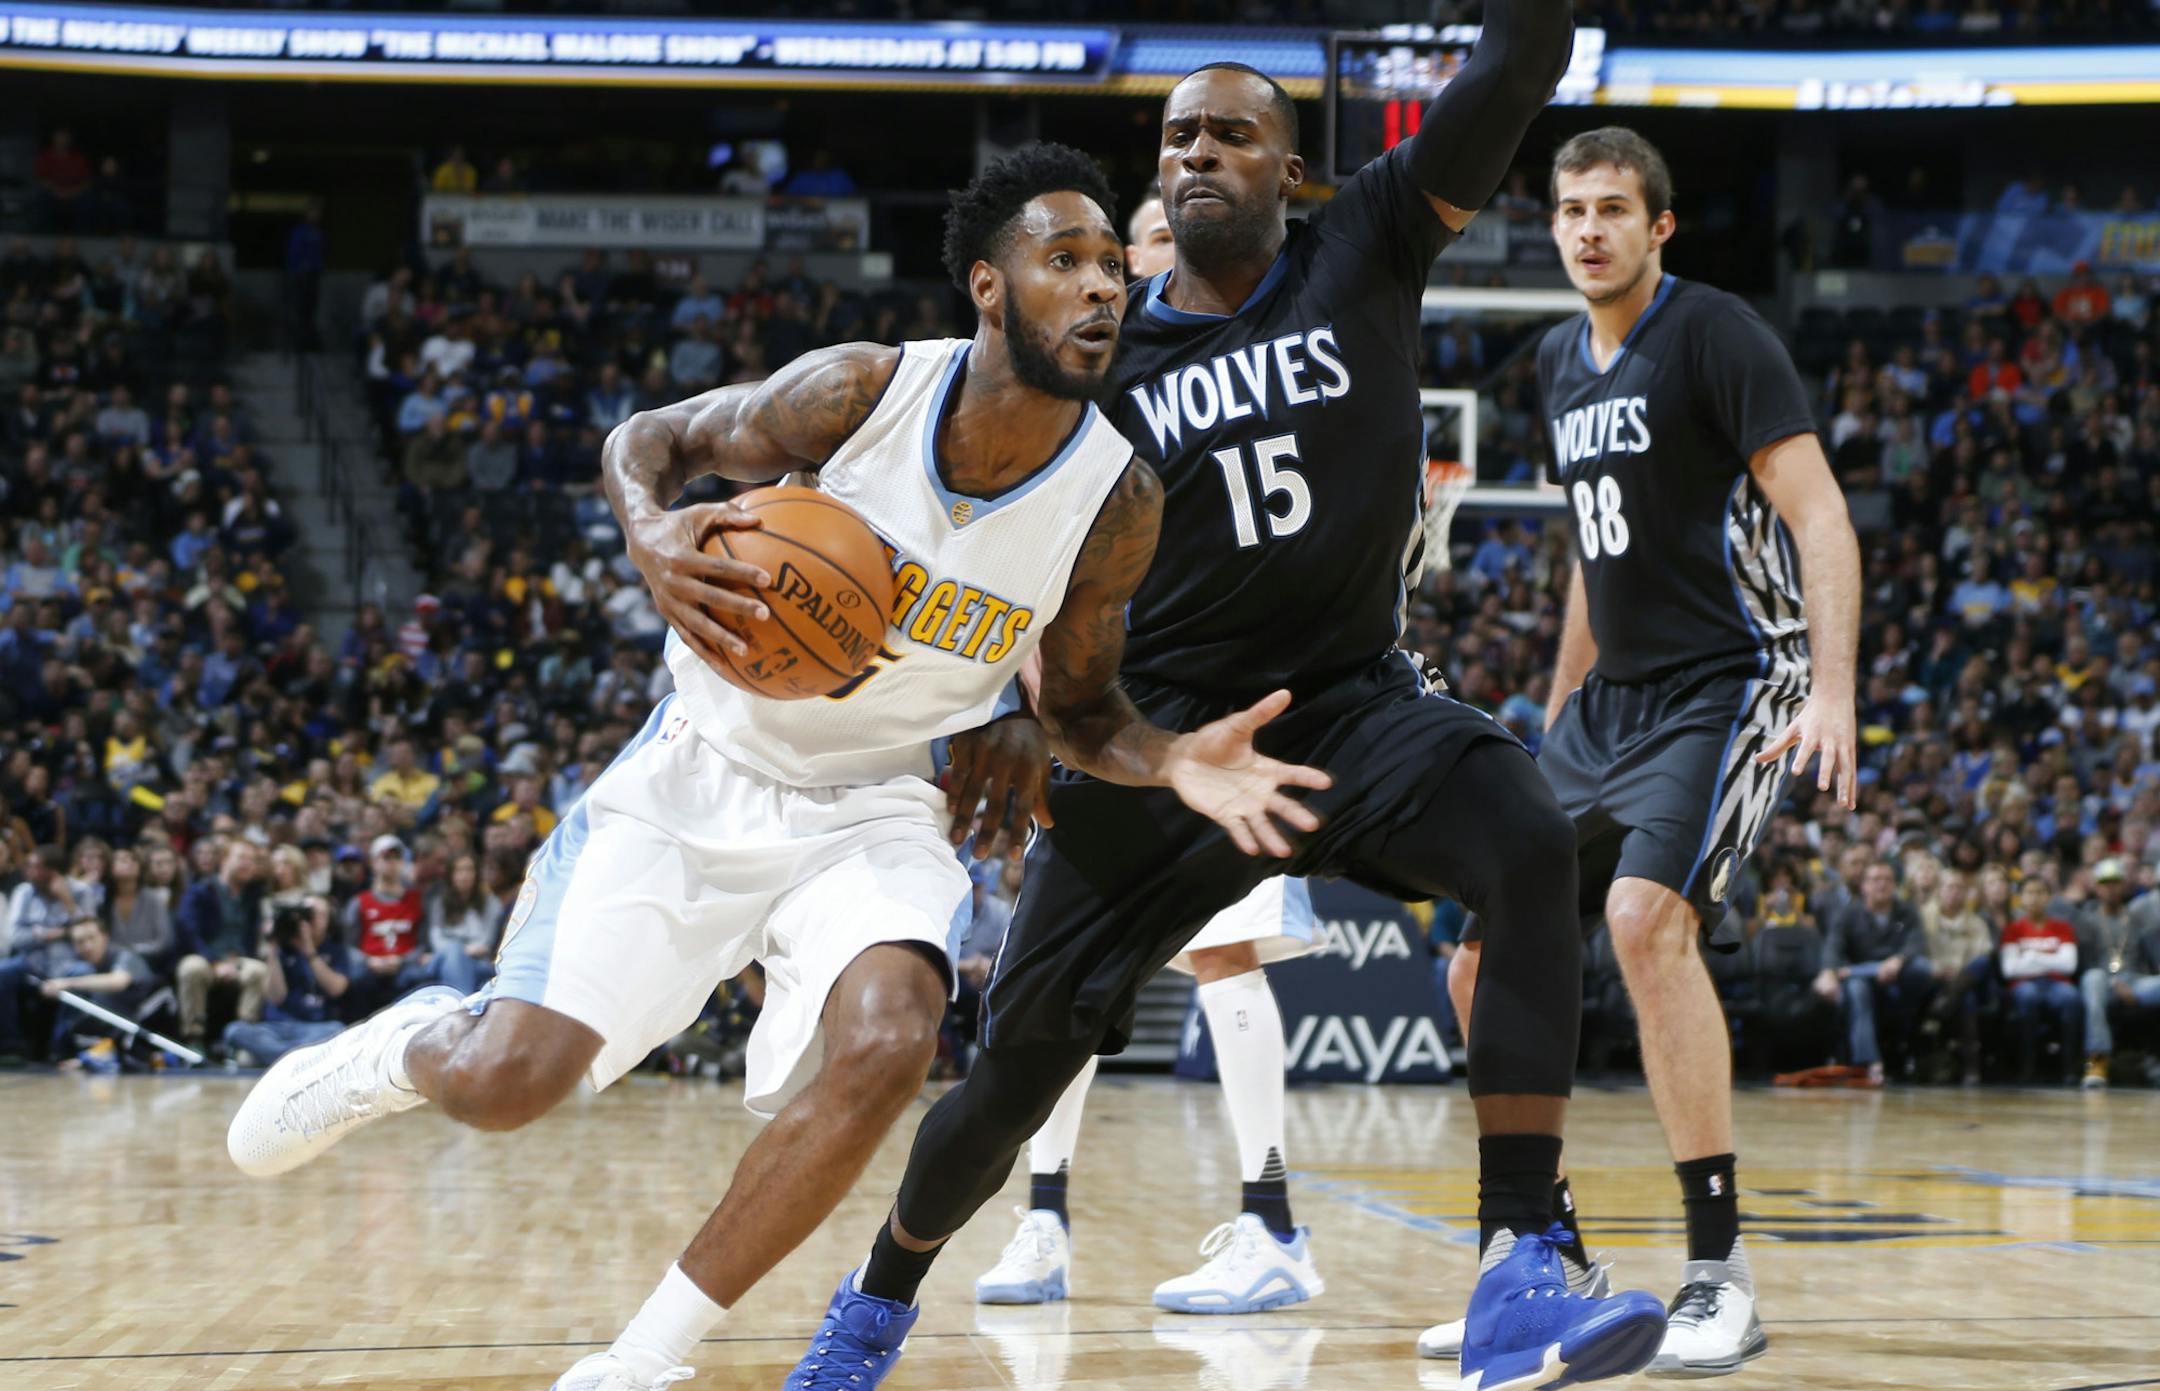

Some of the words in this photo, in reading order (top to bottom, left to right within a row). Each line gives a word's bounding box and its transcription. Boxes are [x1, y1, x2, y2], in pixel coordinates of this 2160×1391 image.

[11, 16, 58, 45] THE
[188, 27, 287, 56] WEEKLY
[289, 29, 367, 58] SHOW
[435, 31, 549, 61] MICHAEL
[553, 33, 661, 63] MALONE
[773, 37, 945, 68] WEDNESDAYS
[949, 39, 982, 69] AT
[1042, 41, 1085, 70] PM
[538, 209, 588, 229] MAKE
[601, 209, 631, 229] THE
[711, 210, 752, 231] CALL
[1128, 323, 1351, 458] WOLVES
[1552, 395, 1651, 477] WOLVES
[1211, 431, 1312, 549] 15
[1572, 475, 1630, 561] 88
[770, 562, 873, 671] SPALDING
[883, 543, 1035, 664] GGETS
[1315, 920, 1411, 970] AYA
